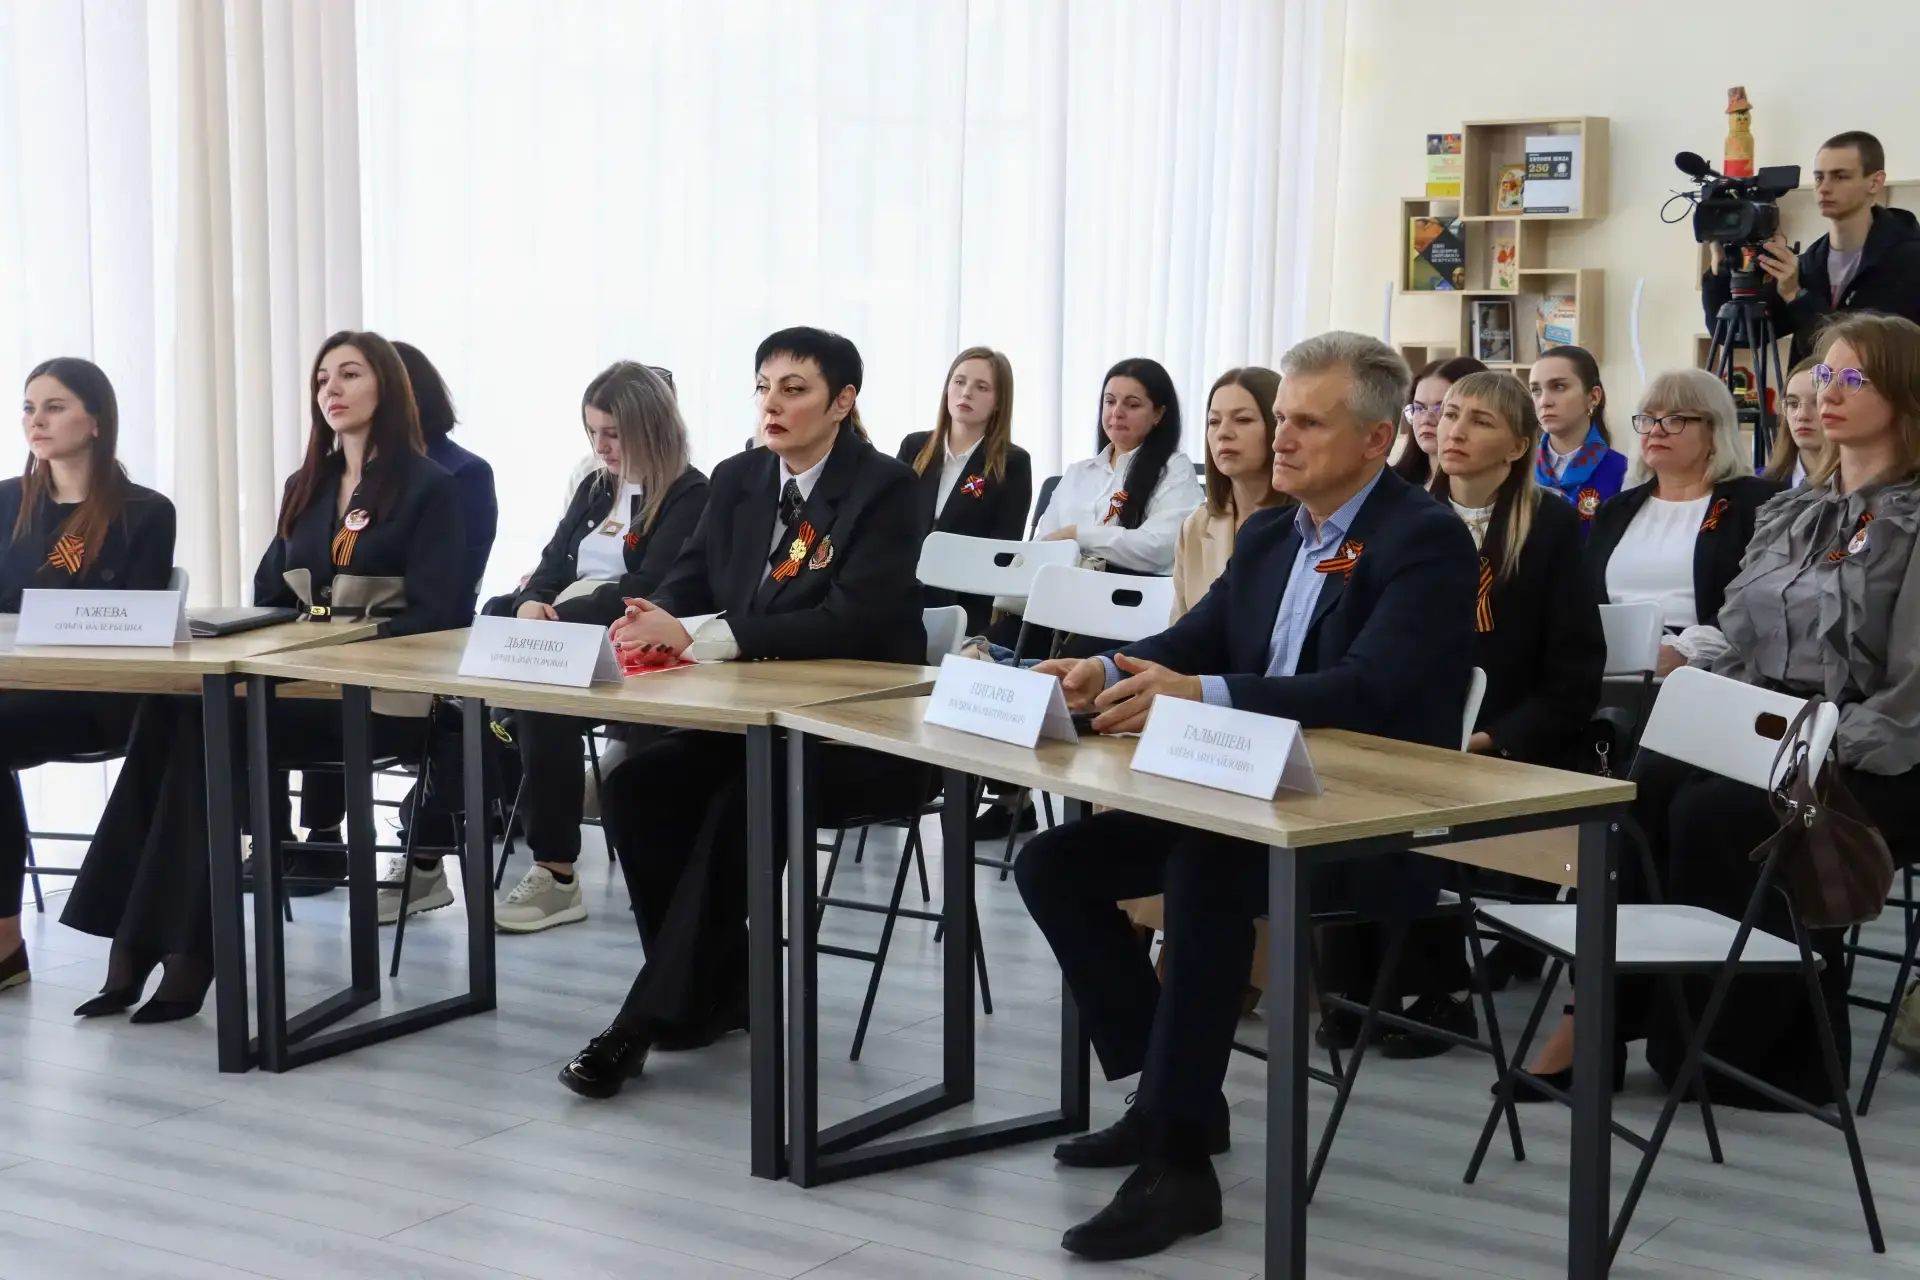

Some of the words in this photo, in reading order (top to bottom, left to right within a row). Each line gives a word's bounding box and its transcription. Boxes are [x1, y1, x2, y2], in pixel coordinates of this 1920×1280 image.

[1528, 163, 1549, 173] 250
[75, 606, 129, 618] ГАЖЕВА
[55, 622, 84, 631] ОЛЬГА
[503, 636, 564, 653] ДЬЯЧЕНКО
[969, 681, 1015, 703] ПИГАРЕВ
[1183, 724, 1252, 751] ГАЛЫШЕВА
